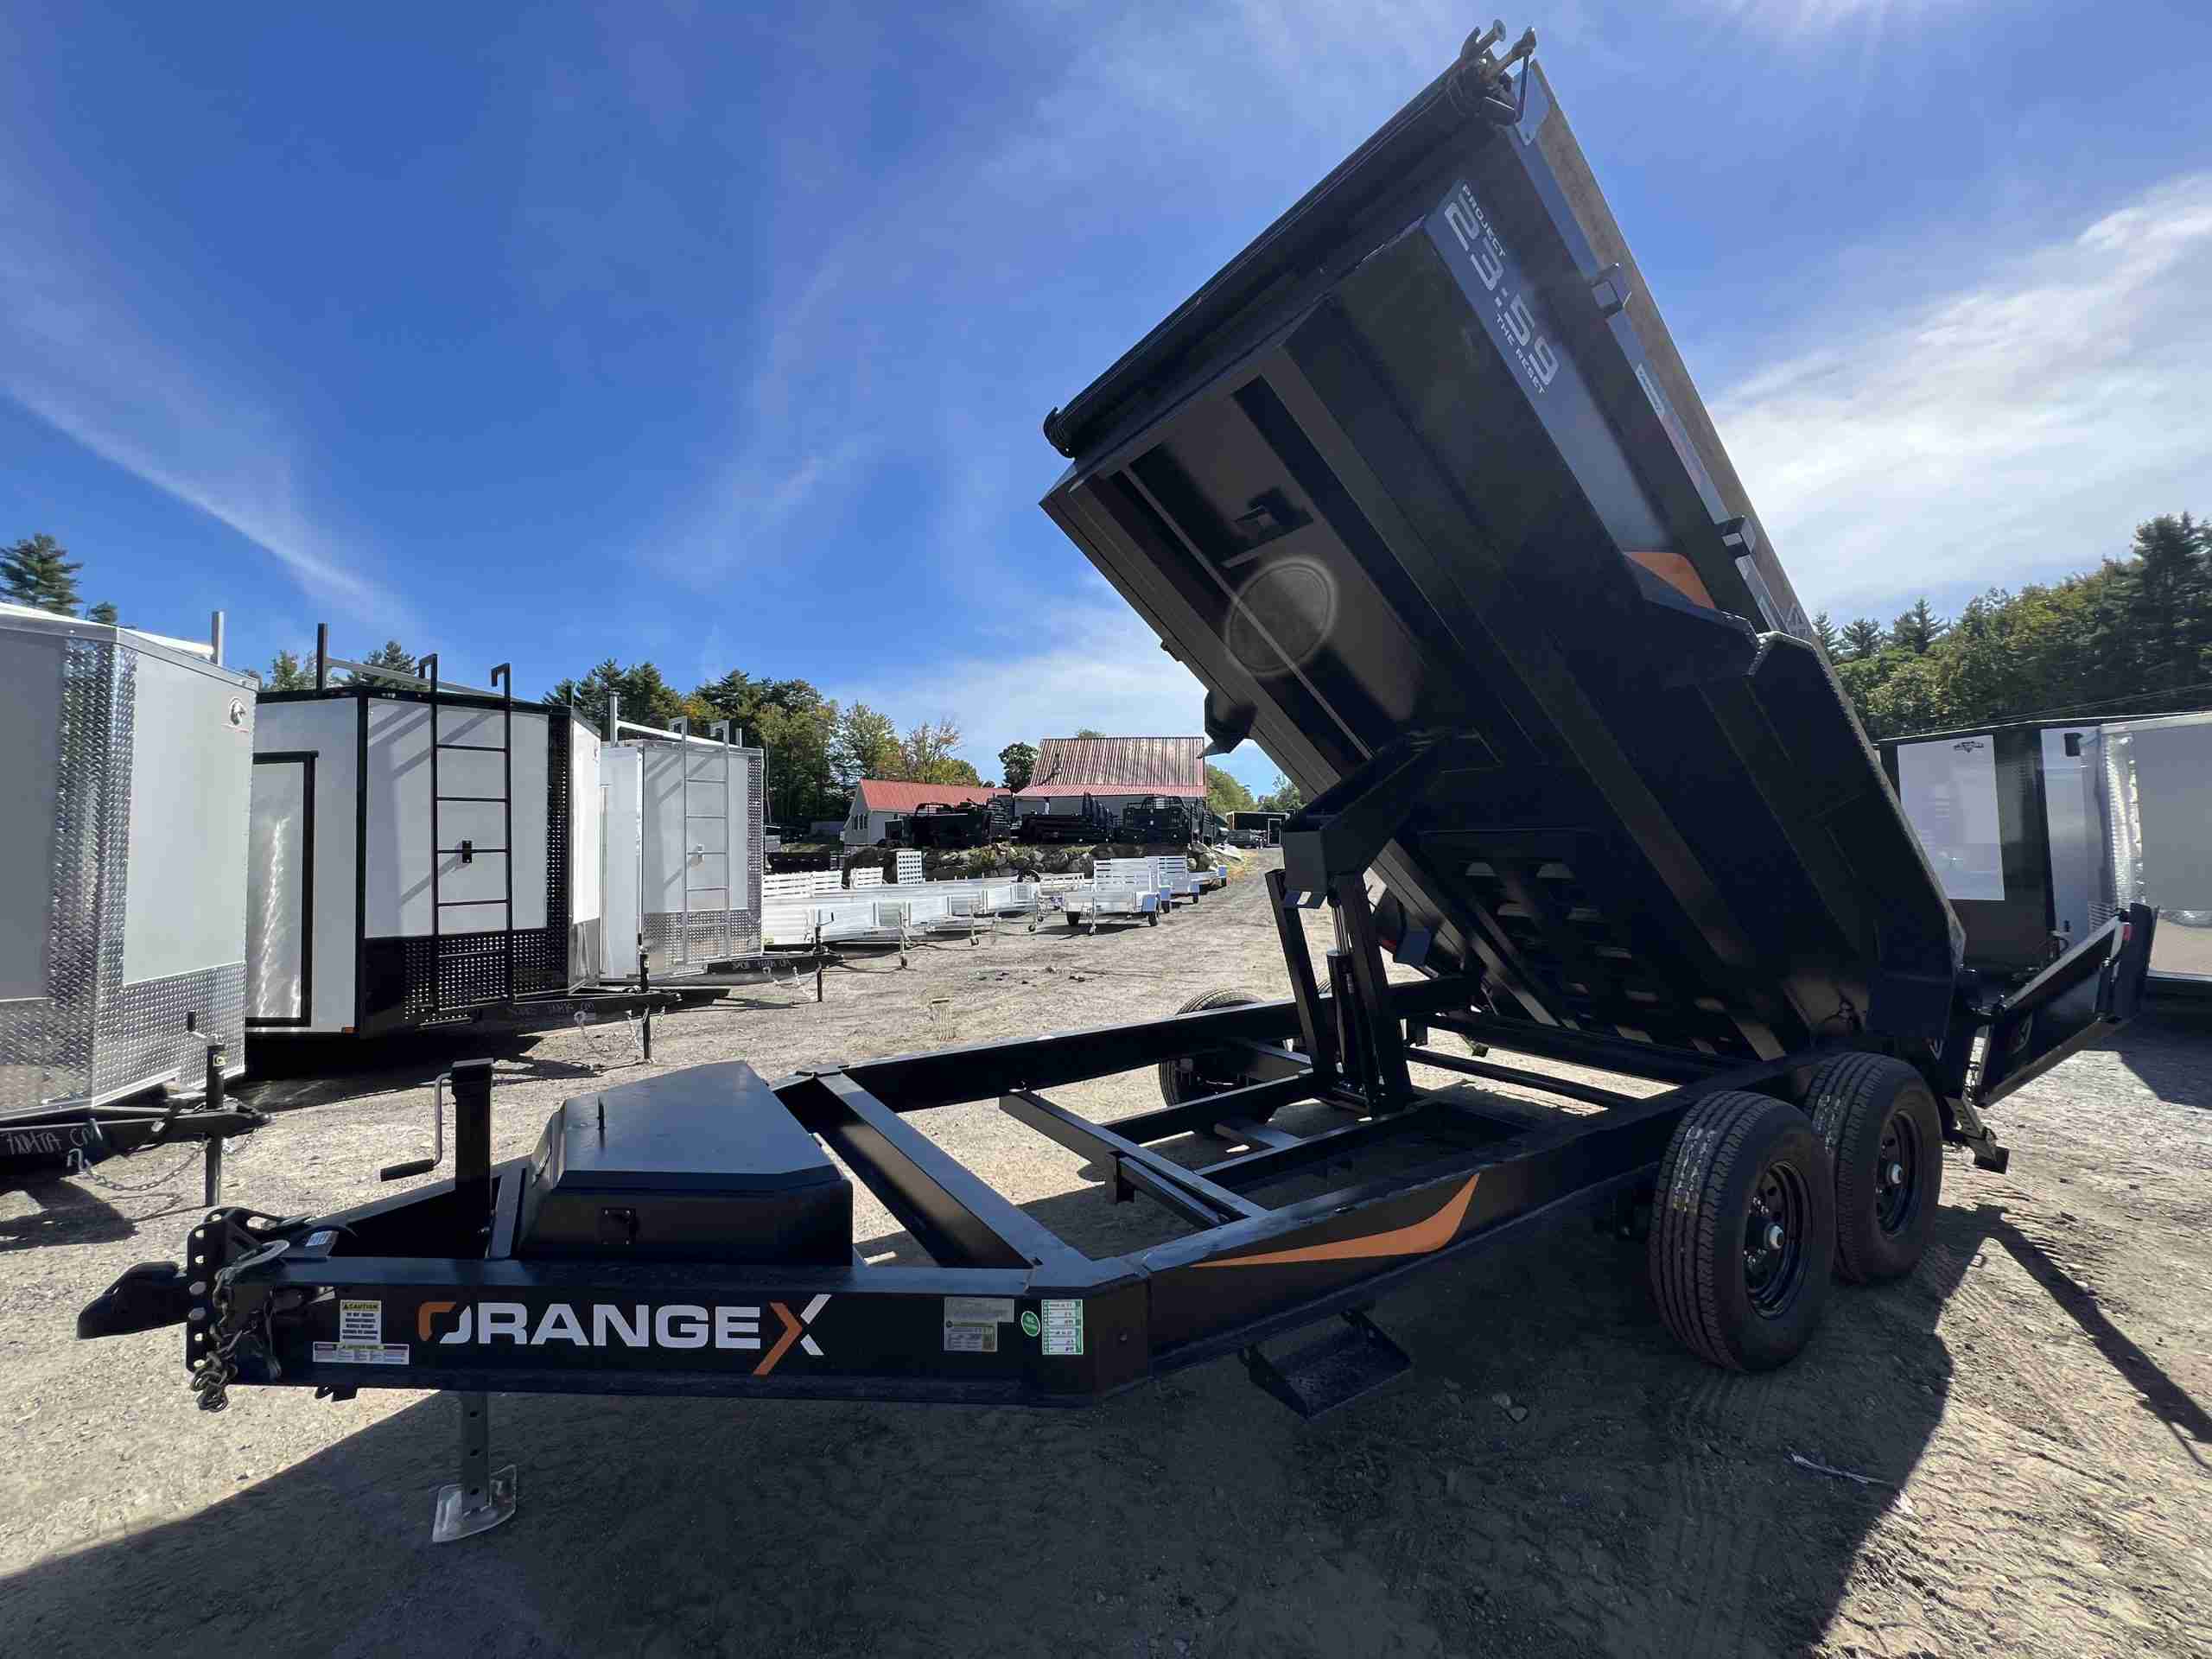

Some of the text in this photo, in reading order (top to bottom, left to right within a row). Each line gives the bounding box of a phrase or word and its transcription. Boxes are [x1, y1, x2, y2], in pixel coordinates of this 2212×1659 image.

[1462, 184, 1506, 257] PROJECT
[1444, 193, 1560, 385] 23:59
[1496, 313, 1546, 394] THE RESET
[417, 1294, 831, 1376] ORANGEX
